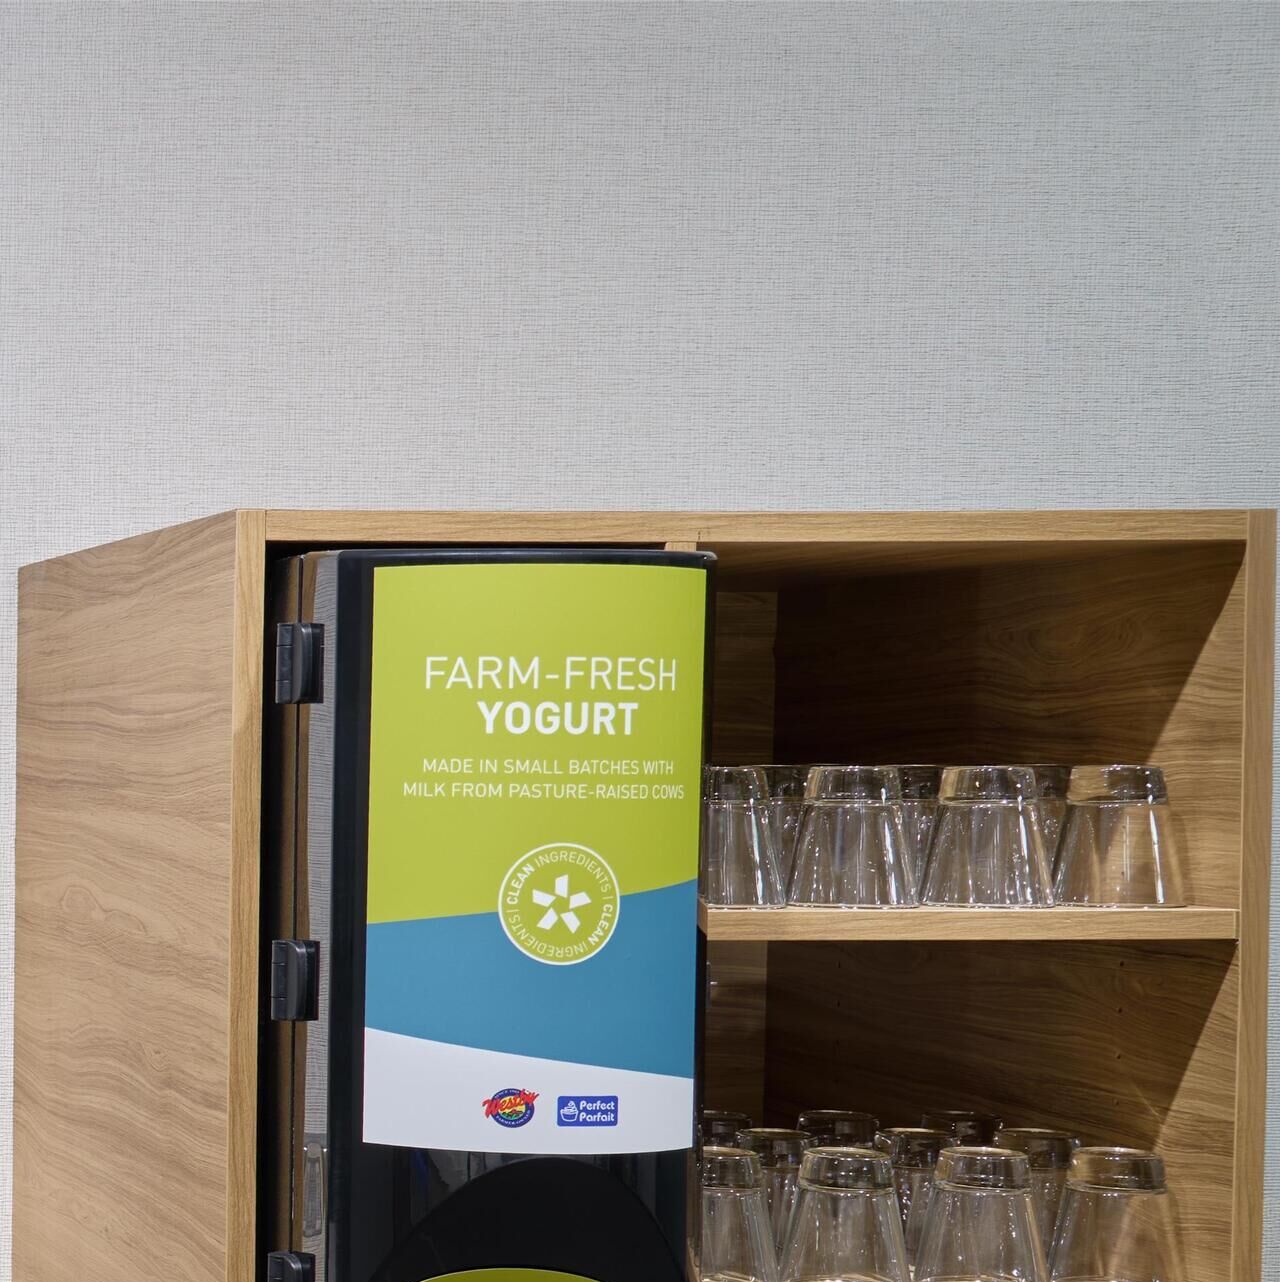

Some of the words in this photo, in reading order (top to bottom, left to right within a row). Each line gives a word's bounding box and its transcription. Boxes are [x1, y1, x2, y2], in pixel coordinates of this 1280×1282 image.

[425, 656, 676, 691] FARM-FRESH
[477, 701, 639, 735] YOGURT
[423, 758, 473, 774] MADE
[480, 759, 497, 774] IN
[504, 759, 563, 774] SMALL
[569, 760, 639, 775] BATCHES
[643, 761, 673, 775] WITH
[403, 782, 446, 797] MILK
[452, 783, 502, 797] FROM
[509, 783, 647, 799] PASTURE-RAISED
[652, 785, 684, 799] COWS
[507, 863, 535, 905] CLEAN
[535, 851, 612, 893] INGREDIENTS
[508, 915, 588, 958] INGREDIENTS
[588, 903, 613, 945] CLEAN
[580, 1101, 615, 1110] Perfect
[580, 1113, 614, 1122] Parfait
